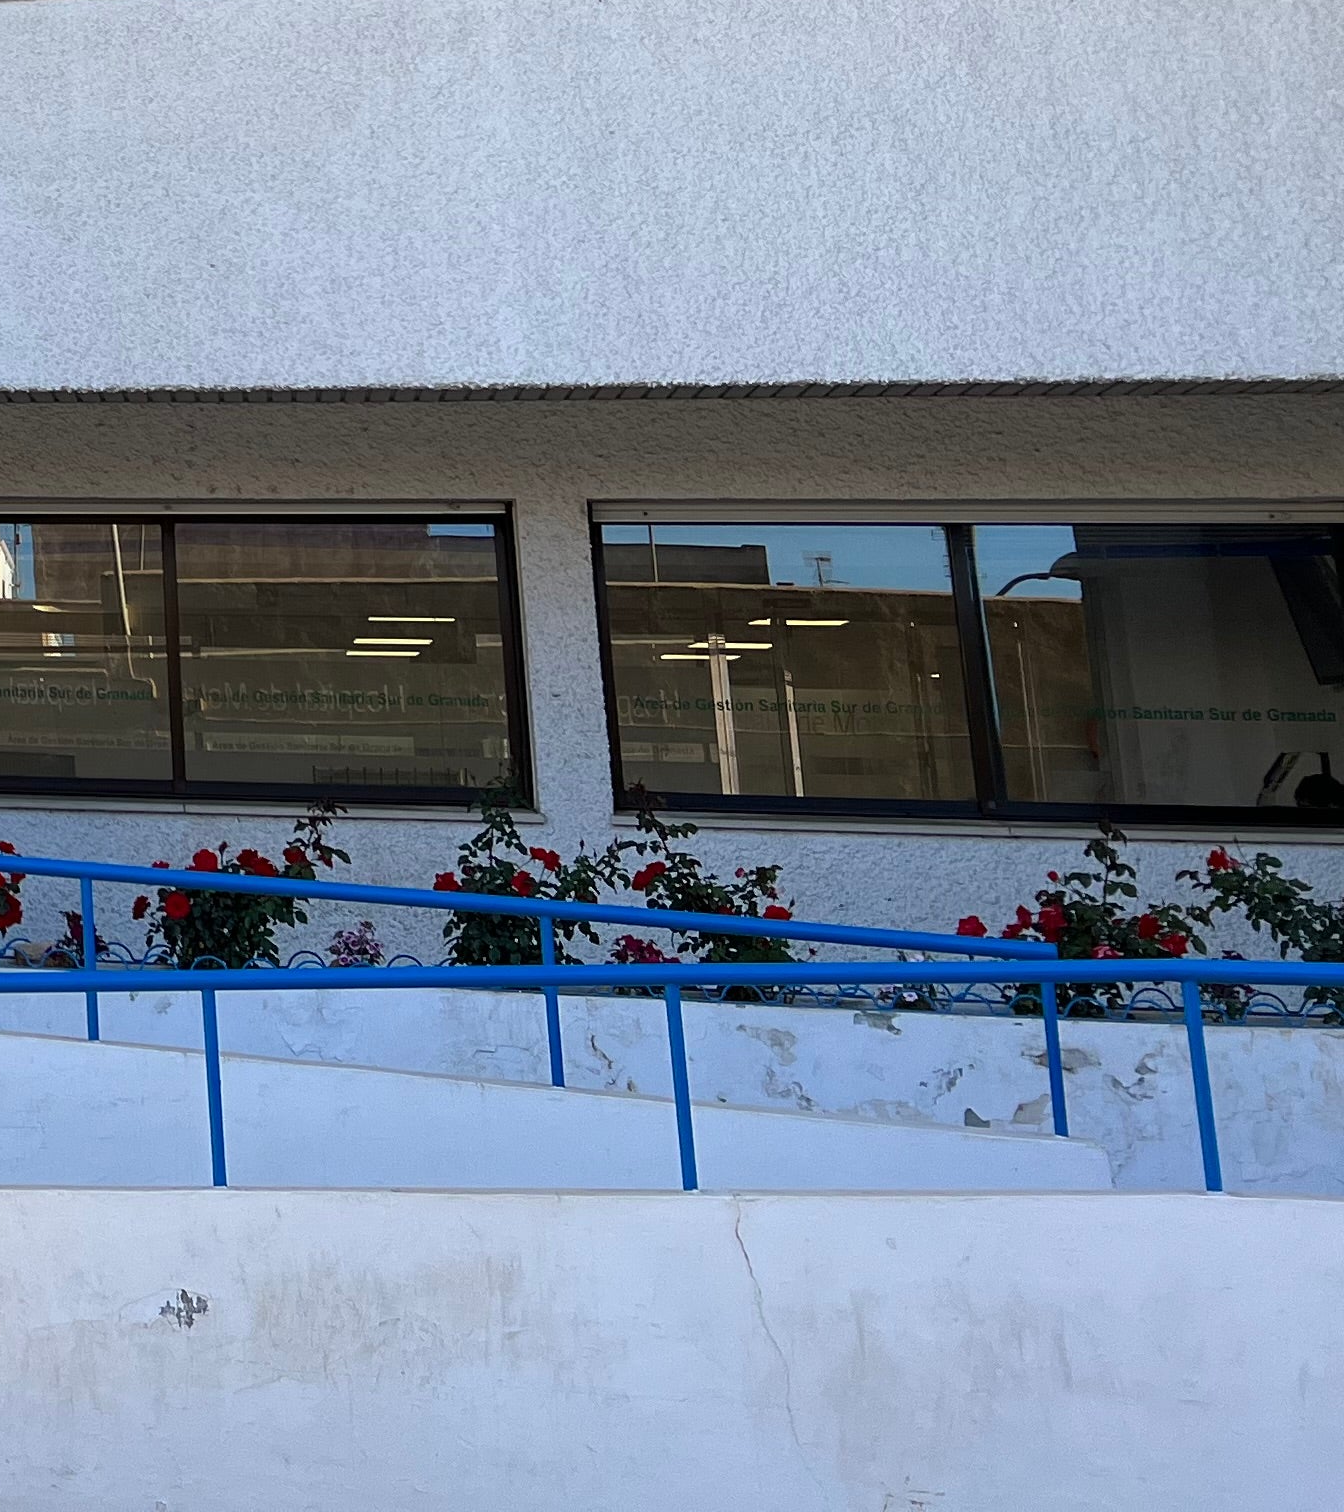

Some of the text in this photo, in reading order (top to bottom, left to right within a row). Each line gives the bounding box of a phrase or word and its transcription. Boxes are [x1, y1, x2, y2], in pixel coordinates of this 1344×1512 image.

[831, 700, 858, 714] Sur
[862, 700, 880, 714] de
[1132, 705, 1204, 721] Sanitaria
[1208, 707, 1237, 721] Sur
[1242, 708, 1262, 721] de
[1266, 708, 1337, 723] Granada
